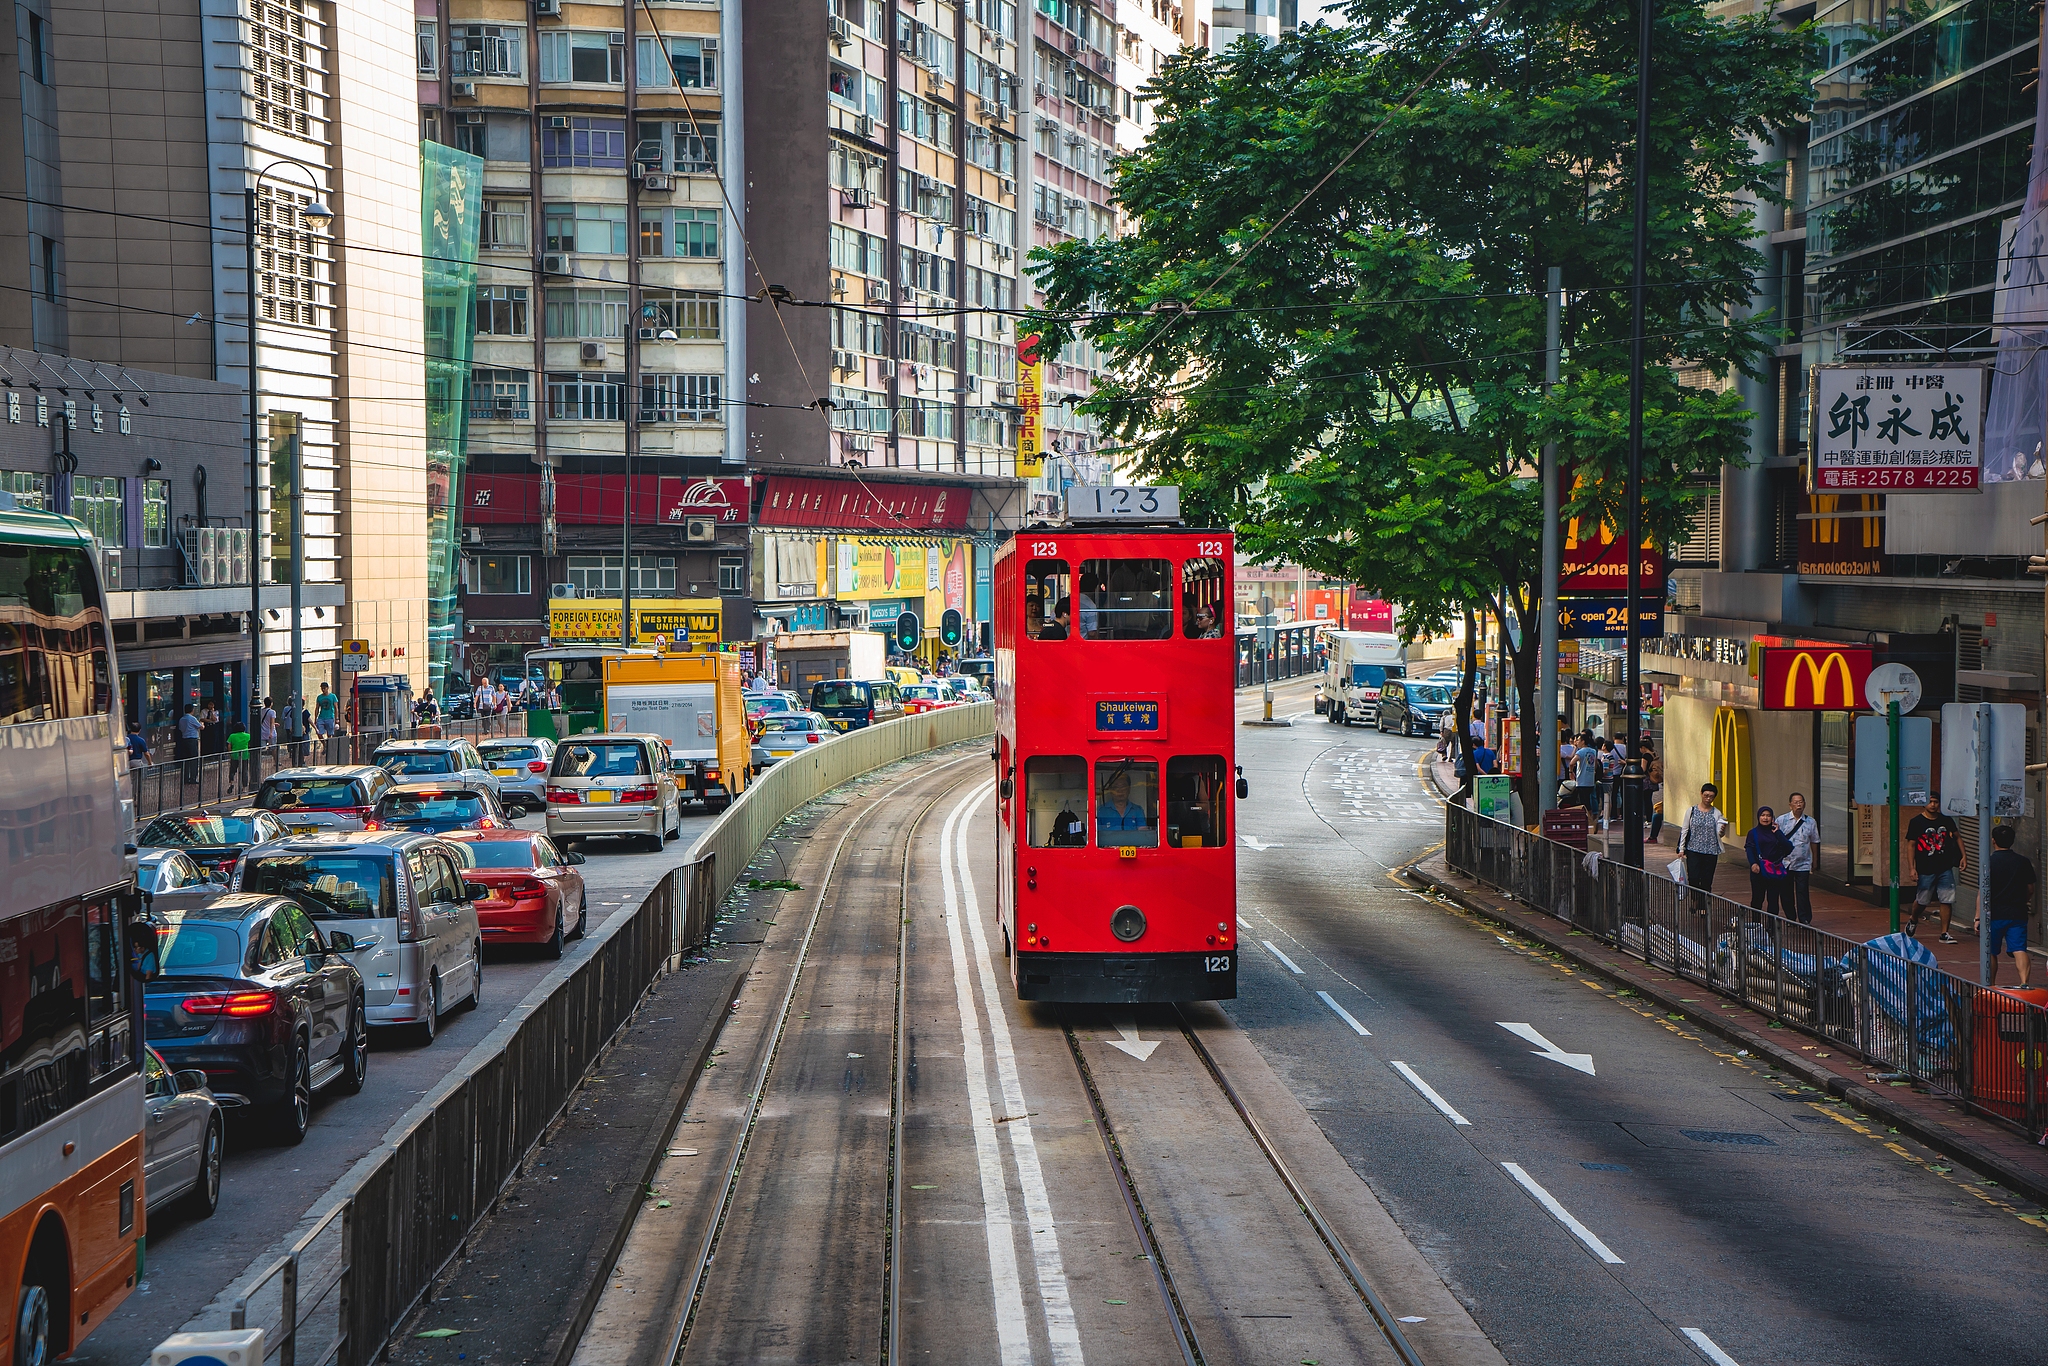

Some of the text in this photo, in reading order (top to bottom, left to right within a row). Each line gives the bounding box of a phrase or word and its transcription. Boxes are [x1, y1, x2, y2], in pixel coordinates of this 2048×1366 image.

[1856, 374, 1945, 391] 註冊 中醫
[1827, 391, 1971, 450] 邱永成
[1823, 450, 1973, 466] 中醫運動創傷診療院
[1823, 470, 1972, 487] 電話:2578 4225
[1095, 487, 1159, 514] 123
[1031, 542, 1058, 557] 123
[1197, 541, 1224, 556] 123
[553, 612, 634, 622] FOREIGN EXCHANE
[642, 616, 715, 631] WESTERN WU
[1581, 607, 1658, 625] open 24 ours
[676, 628, 687, 640] P
[1099, 702, 1158, 712] Shaukeiwan
[1120, 849, 1135, 857] 109
[1204, 955, 1230, 973] 123
